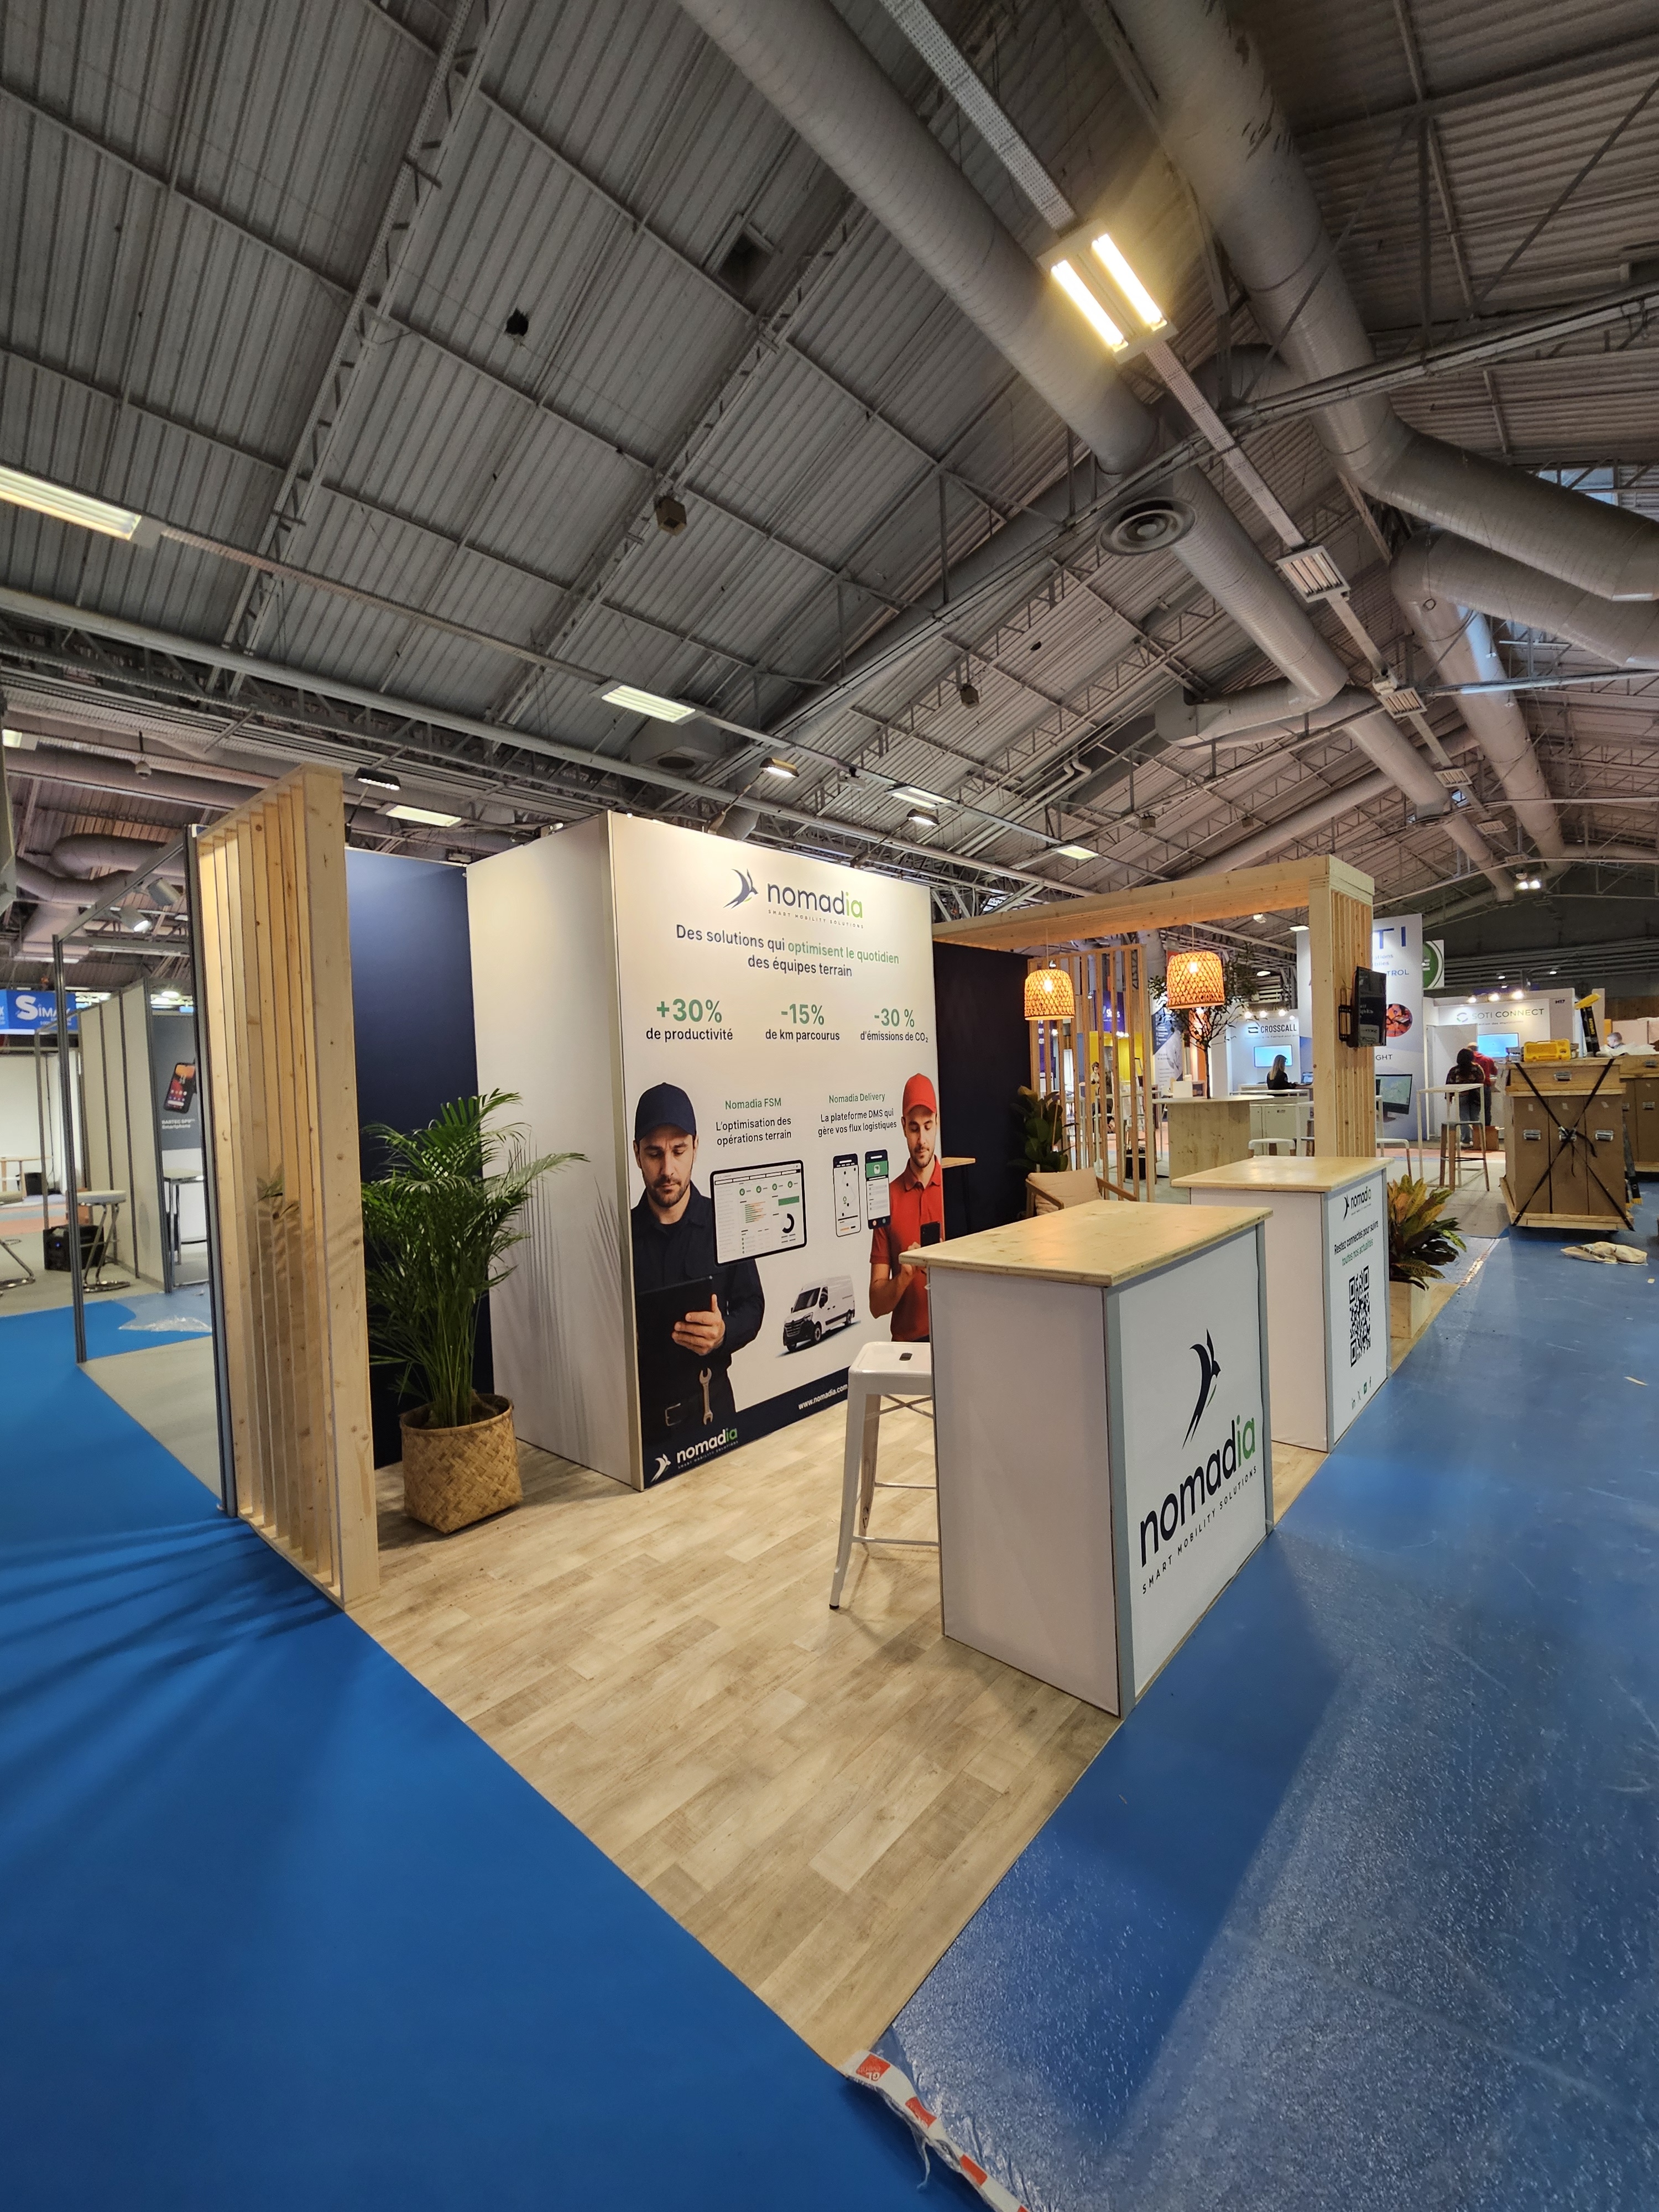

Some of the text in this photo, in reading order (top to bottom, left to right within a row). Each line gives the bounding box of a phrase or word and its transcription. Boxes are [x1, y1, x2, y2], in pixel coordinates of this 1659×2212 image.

[768, 883, 863, 918] nomadia
[769, 909, 864, 928] SMART MOBILITY SOLUTIONS
[676, 924, 899, 964] Des solutions qui optimisent le quotidien
[1373, 926, 1406, 949] TI
[748, 954, 852, 977] des équipes terrain
[656, 998, 722, 1023] +30%
[781, 1004, 825, 1025] -15%
[1495, 1008, 1545, 1019] CONNECT
[646, 1027, 733, 1042] de productivité
[765, 1029, 840, 1042] de km parcourus
[860, 1031, 904, 1041] d'émissions
[905, 1031, 914, 1041] de
[1261, 1024, 1297, 1033] CROSSCALL
[725, 1098, 781, 1110] Nomadia FSM
[829, 1093, 885, 1104] Nomadia Delivery
[716, 1117, 791, 1133] L'optimisation des
[821, 1108, 894, 1124] La plateforme DMS qui
[818, 1126, 834, 1138] gère
[849, 1124, 862, 1132] flux
[863, 1120, 897, 1132] logistiques
[717, 1130, 791, 1147] opérations terrain
[798, 1384, 848, 1410] www.nomadia.com
[676, 1428, 738, 1464] nomadia
[1140, 1415, 1256, 1568] nomadia
[1142, 1465, 1258, 1595] SMART MOBILITY SOLUTIONS
